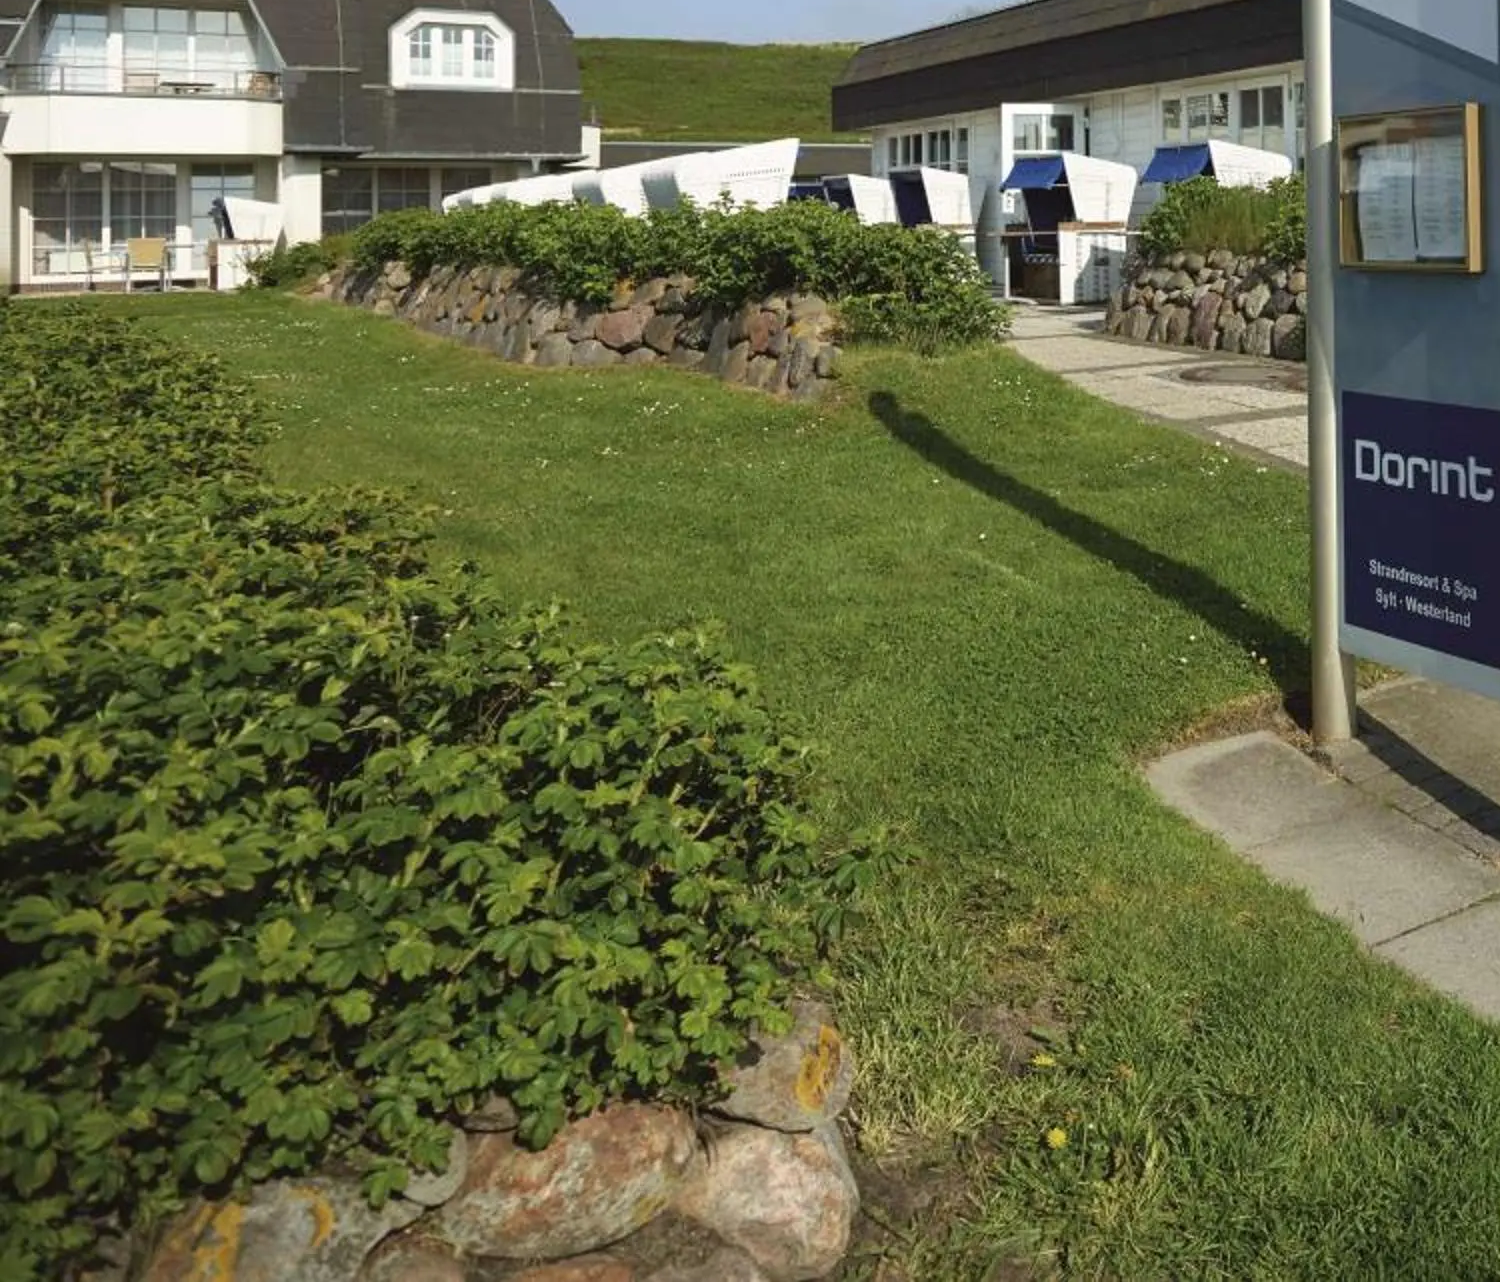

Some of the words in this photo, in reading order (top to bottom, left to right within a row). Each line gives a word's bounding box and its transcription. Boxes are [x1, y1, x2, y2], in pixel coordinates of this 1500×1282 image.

[1354, 438, 1495, 503] Dorint
[1368, 558, 1439, 592] Strandresort
[1442, 577, 1452, 594] &
[1453, 579, 1478, 601] Spa
[1375, 587, 1398, 610] Sylt
[1404, 595, 1472, 628] Westerland
